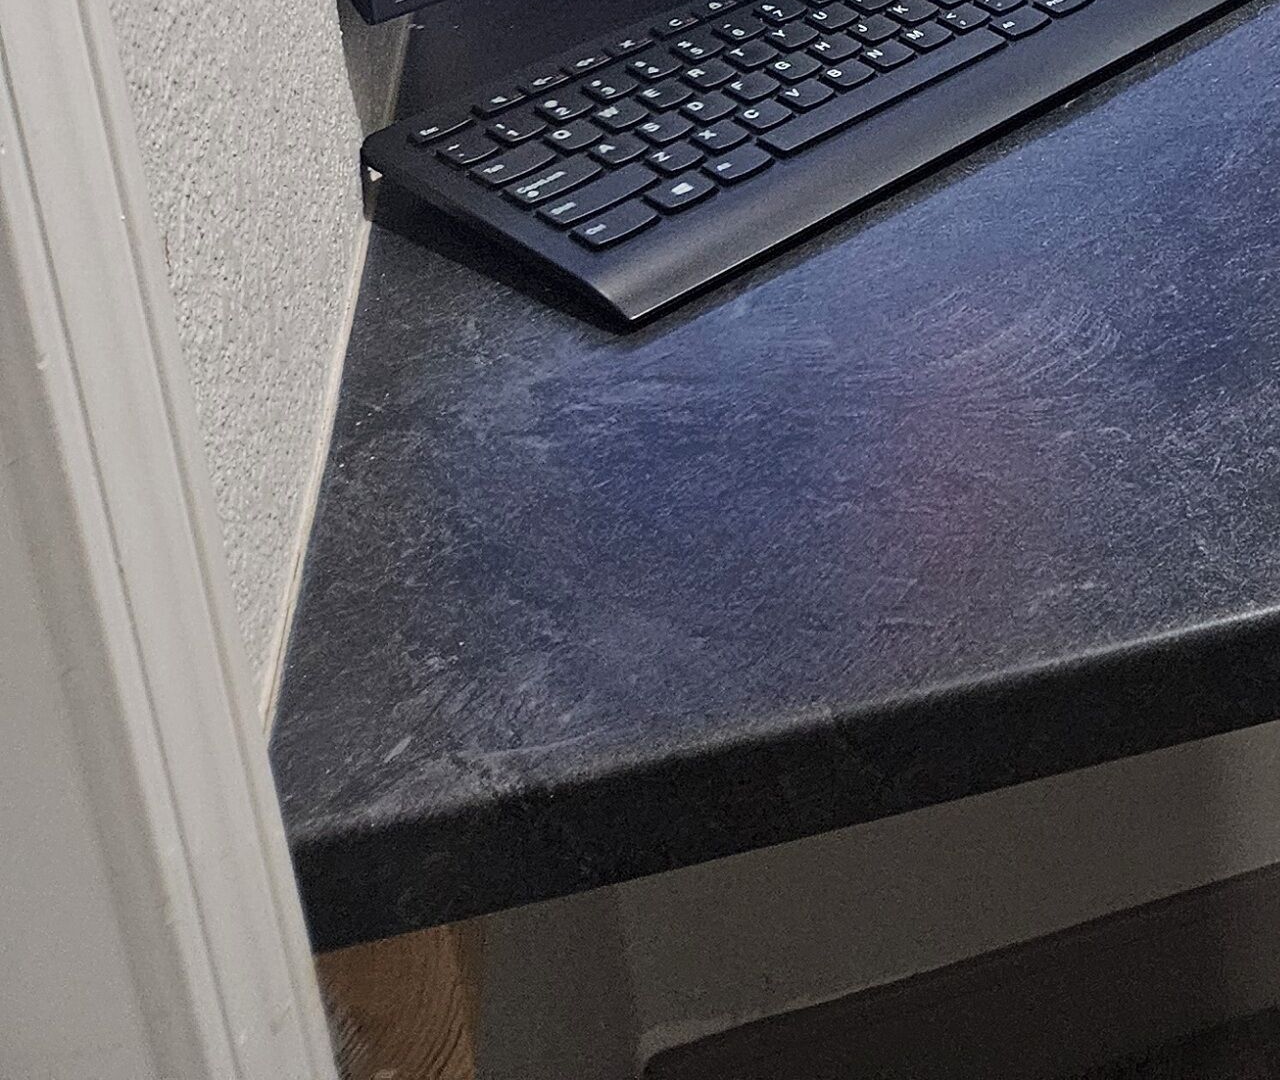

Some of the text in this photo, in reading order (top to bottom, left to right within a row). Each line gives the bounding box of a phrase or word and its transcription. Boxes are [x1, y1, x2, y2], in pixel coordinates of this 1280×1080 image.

[892, 5, 909, 14] K
[812, 11, 828, 20] U
[857, 24, 868, 32] J
[771, 29, 786, 38] Y
[906, 29, 924, 40] M
[814, 41, 831, 51] H
[730, 48, 744, 57] T
[866, 49, 884, 59] N
[774, 61, 791, 70] G
[687, 68, 706, 78] R
[826, 69, 842, 78] B
[730, 81, 743, 91] F
[642, 88, 661, 98] E
[785, 88, 800, 97] V
[743, 109, 760, 119] C
[642, 122, 660, 132] S
[698, 129, 717, 140] X
[652, 151, 671, 162] Z
